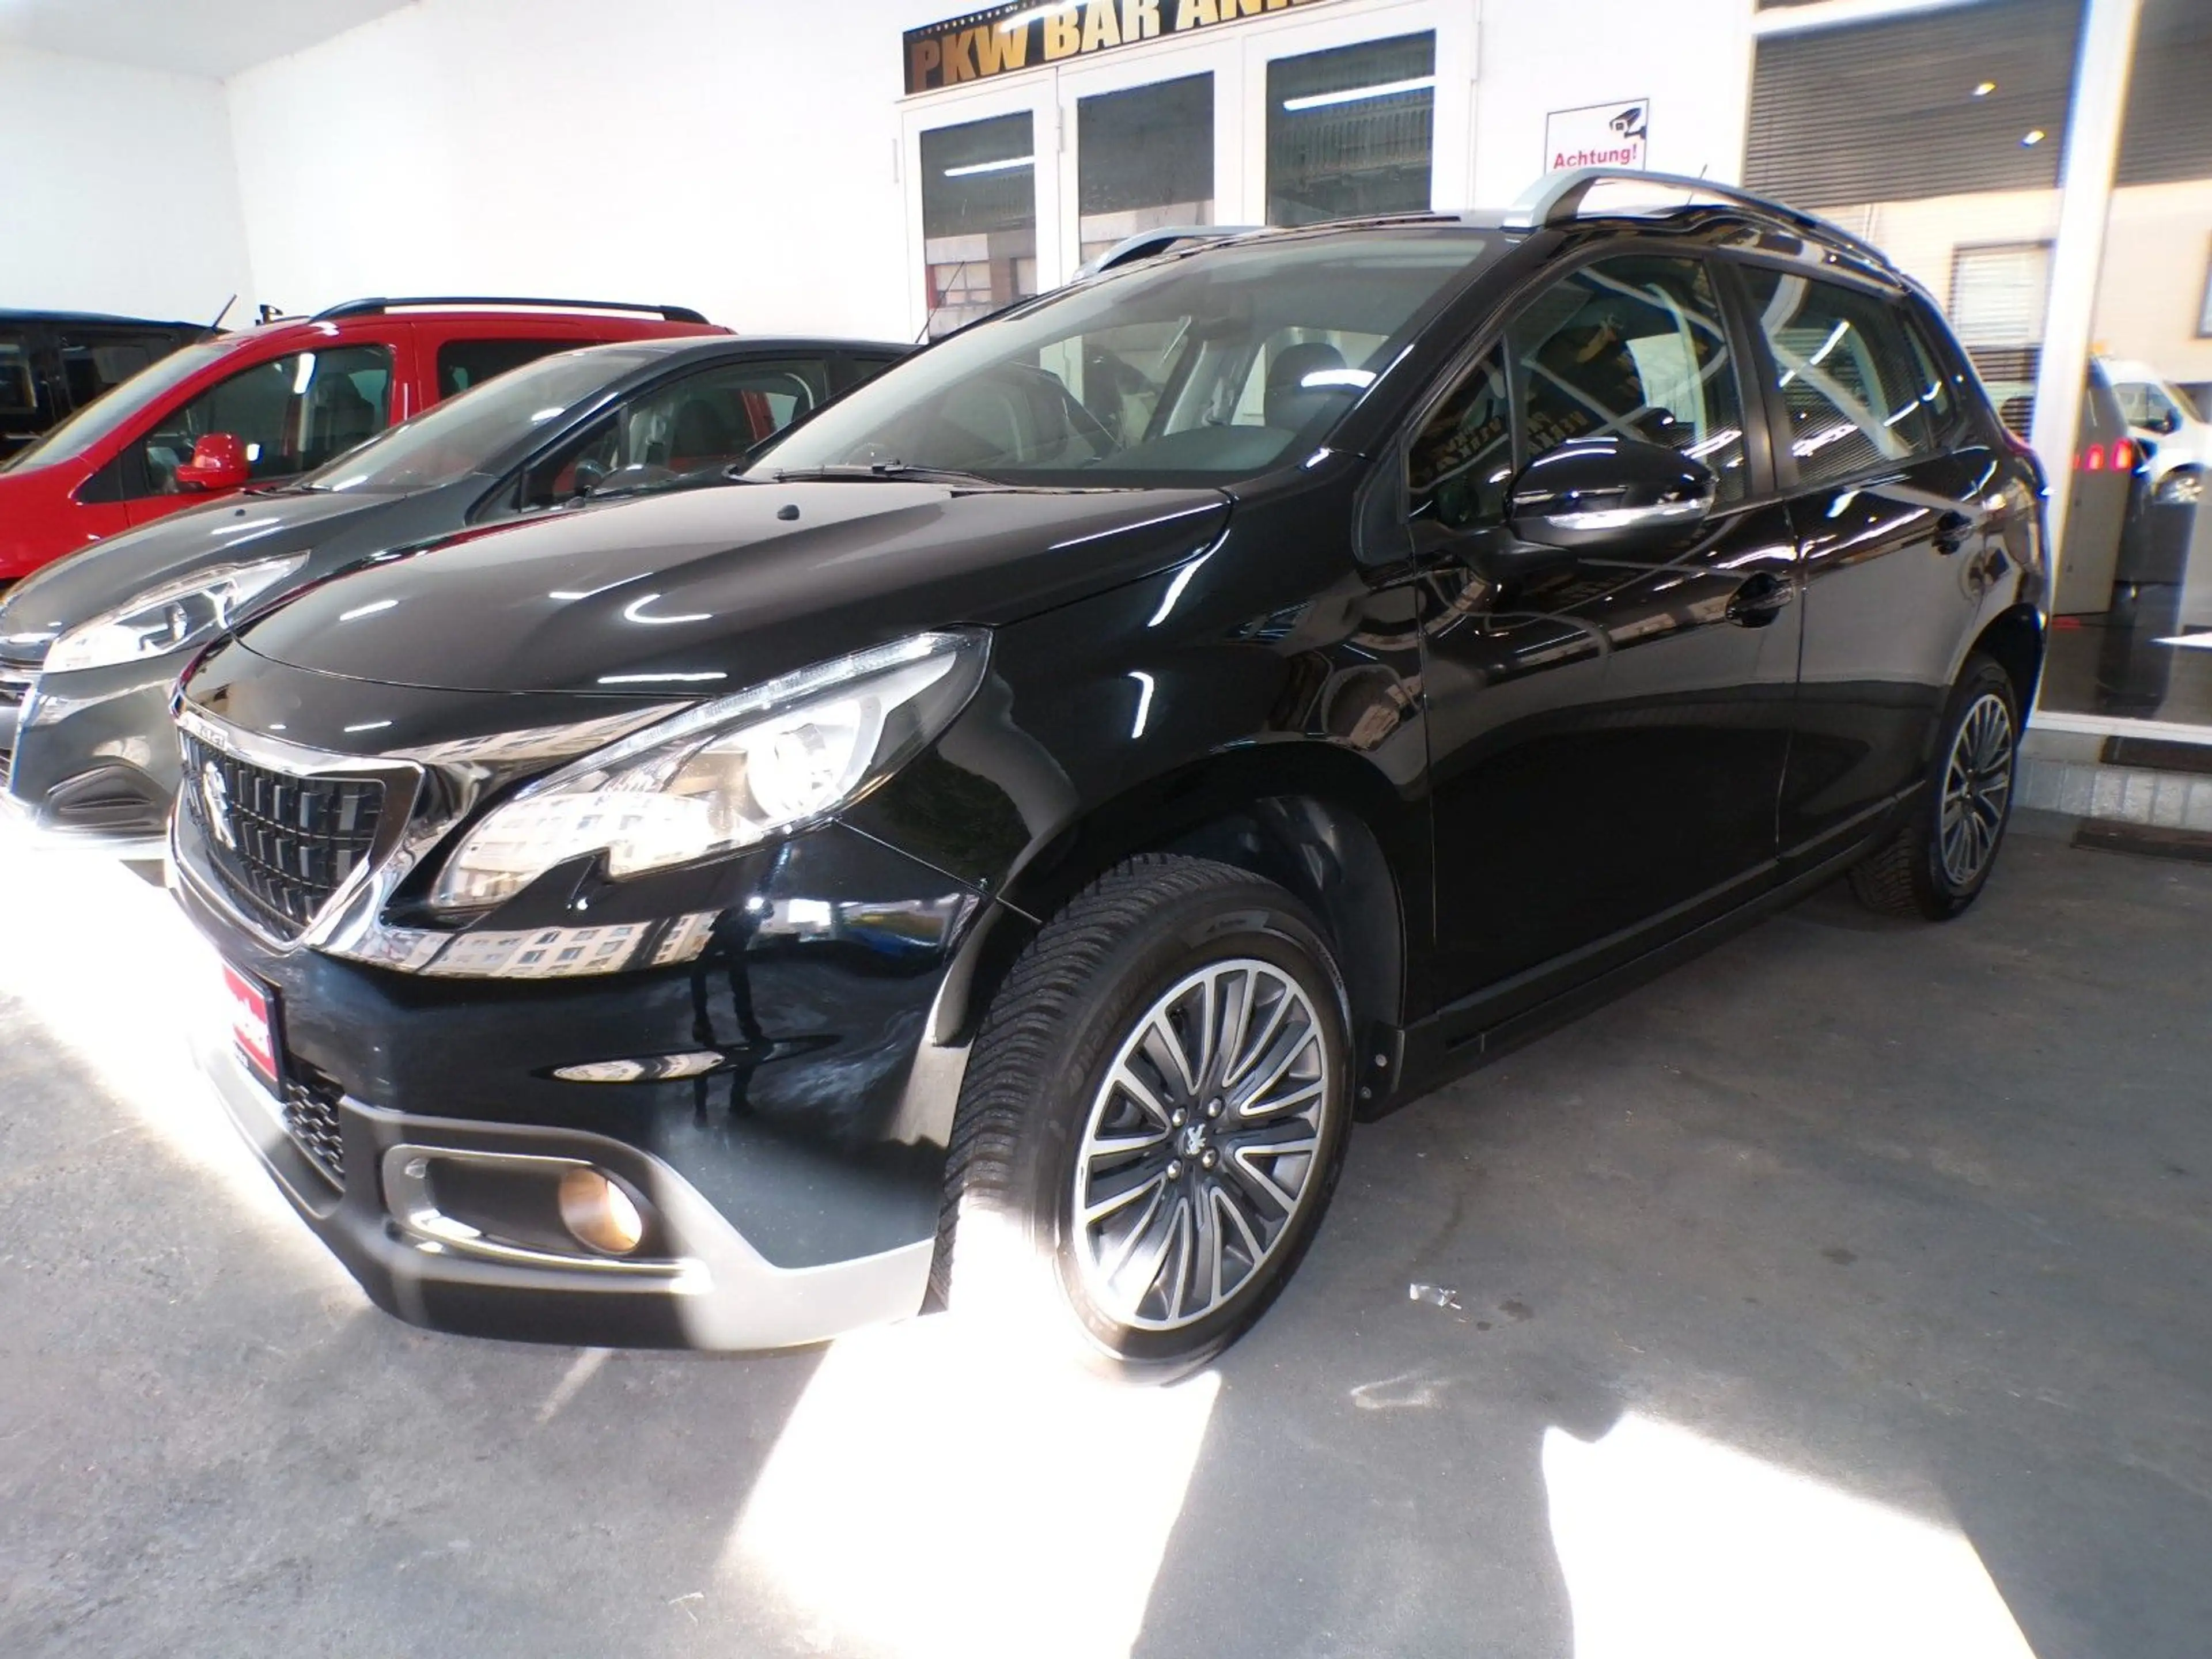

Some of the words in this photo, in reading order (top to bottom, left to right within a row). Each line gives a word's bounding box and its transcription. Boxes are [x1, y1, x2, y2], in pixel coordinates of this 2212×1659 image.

[911, 22, 1029, 94] PKW
[1043, 0, 1160, 61] BAR
[1554, 143, 1637, 169] Achtung!
